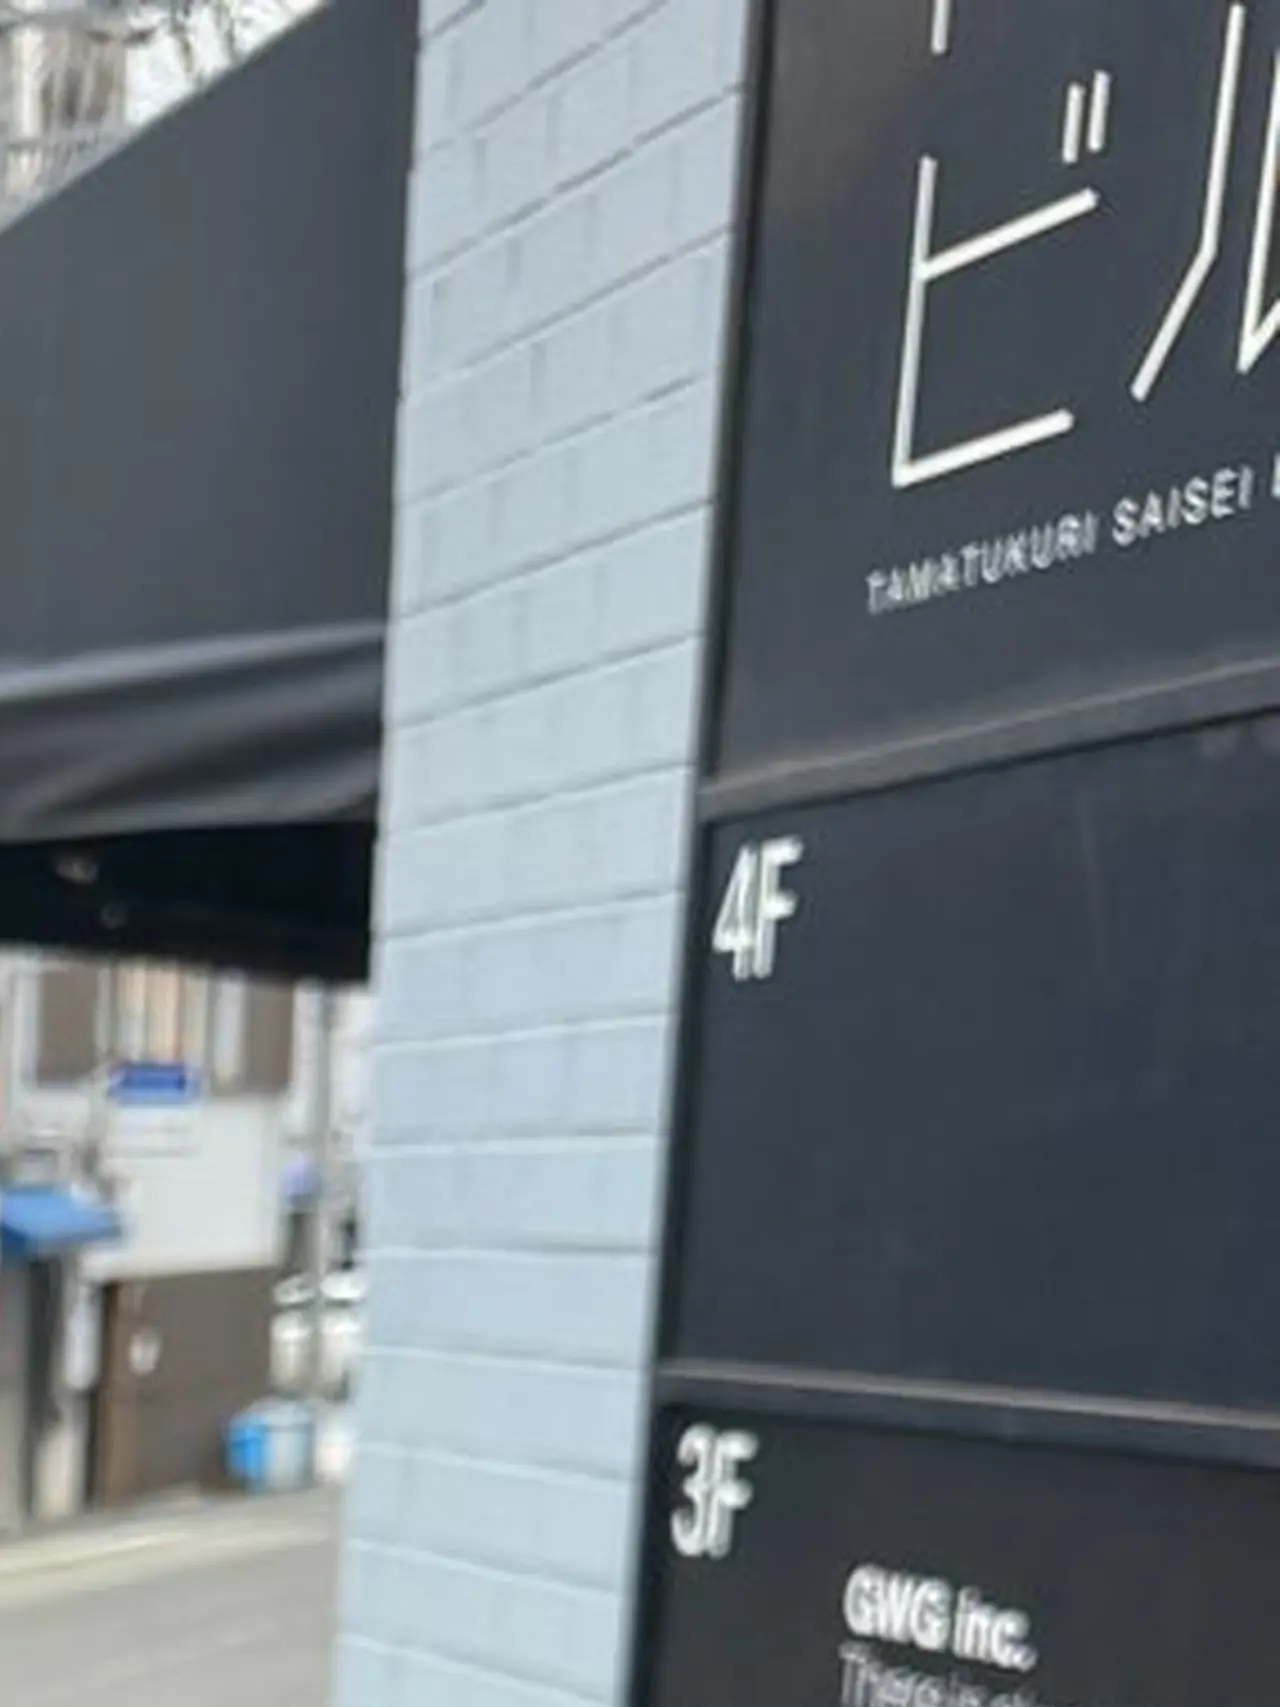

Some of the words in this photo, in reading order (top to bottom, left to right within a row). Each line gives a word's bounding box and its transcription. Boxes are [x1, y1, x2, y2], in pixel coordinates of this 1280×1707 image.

[866, 511, 1097, 615] TAMATUKURI
[1111, 464, 1254, 547] SAISEI
[712, 835, 804, 982] 4F
[671, 1424, 758, 1558] 3F
[844, 1564, 952, 1652] GWG
